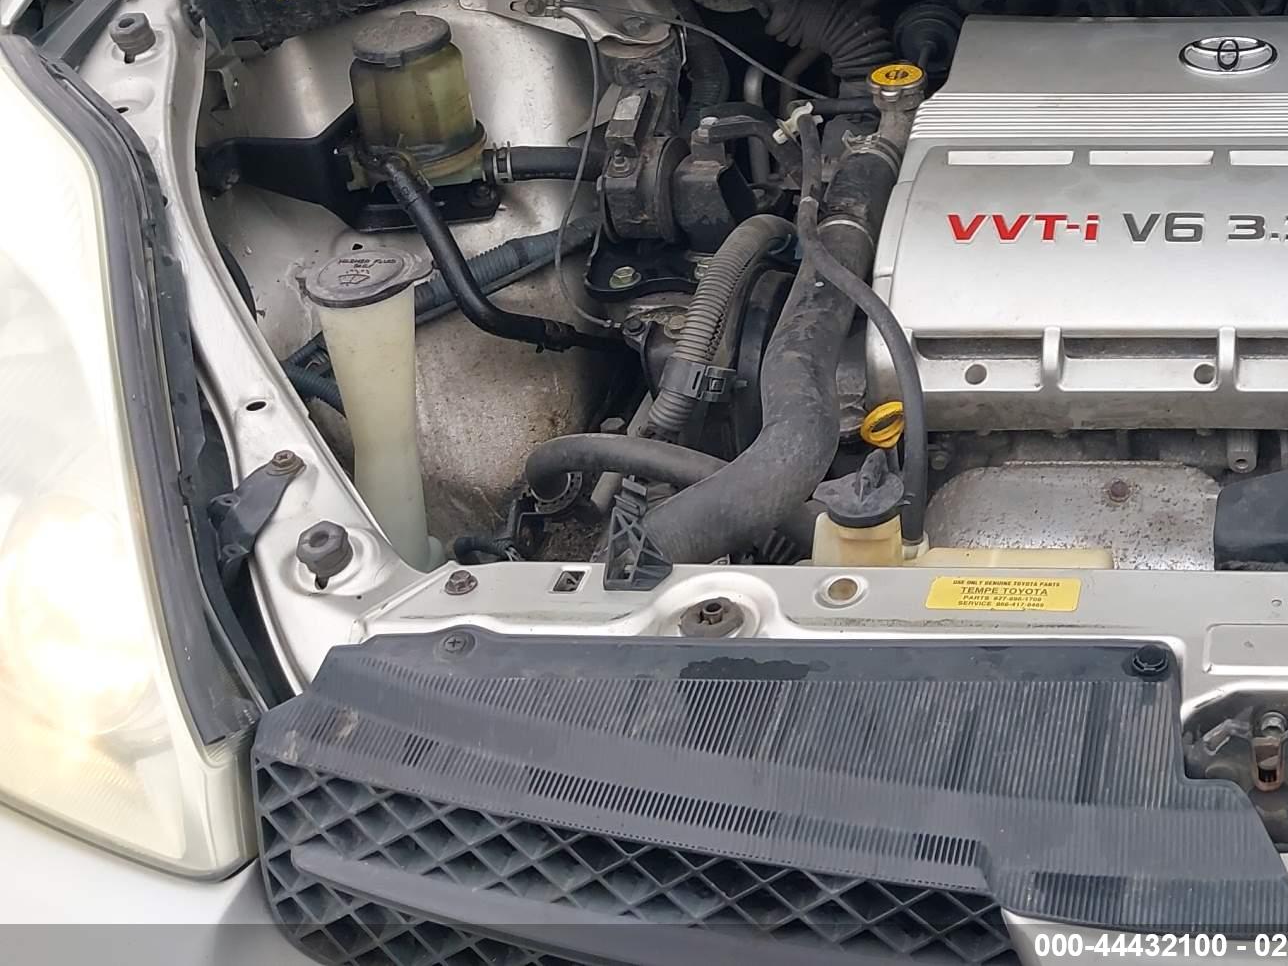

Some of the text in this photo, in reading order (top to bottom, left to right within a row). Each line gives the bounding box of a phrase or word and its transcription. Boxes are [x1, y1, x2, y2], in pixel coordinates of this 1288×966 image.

[946, 212, 1100, 243] VVT-i
[1123, 212, 1205, 244] V6
[961, 586, 1048, 596] TEMPE TOYOTA
